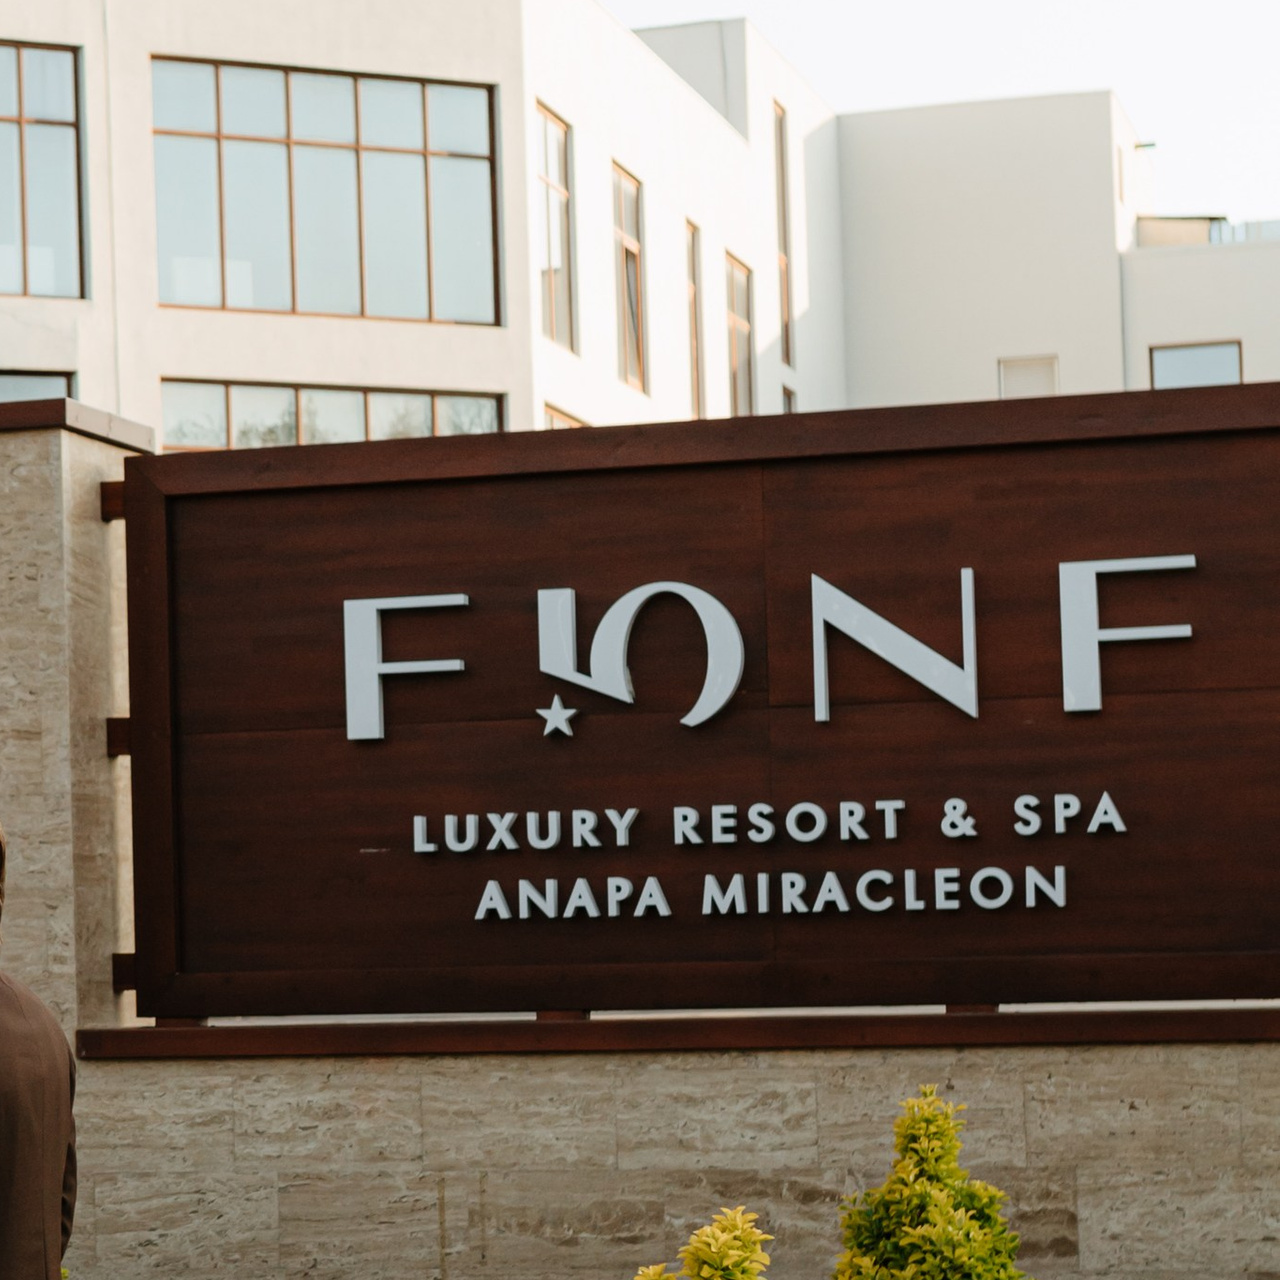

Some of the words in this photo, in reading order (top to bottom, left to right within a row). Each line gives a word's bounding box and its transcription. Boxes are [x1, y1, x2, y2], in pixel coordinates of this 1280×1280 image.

[412, 806, 639, 854] LUXURY
[673, 799, 907, 846] RESORT
[939, 797, 978, 839] &
[1013, 790, 1128, 837] SPA
[474, 876, 673, 921] ANAPA
[701, 864, 1067, 916] MIRACLEON
